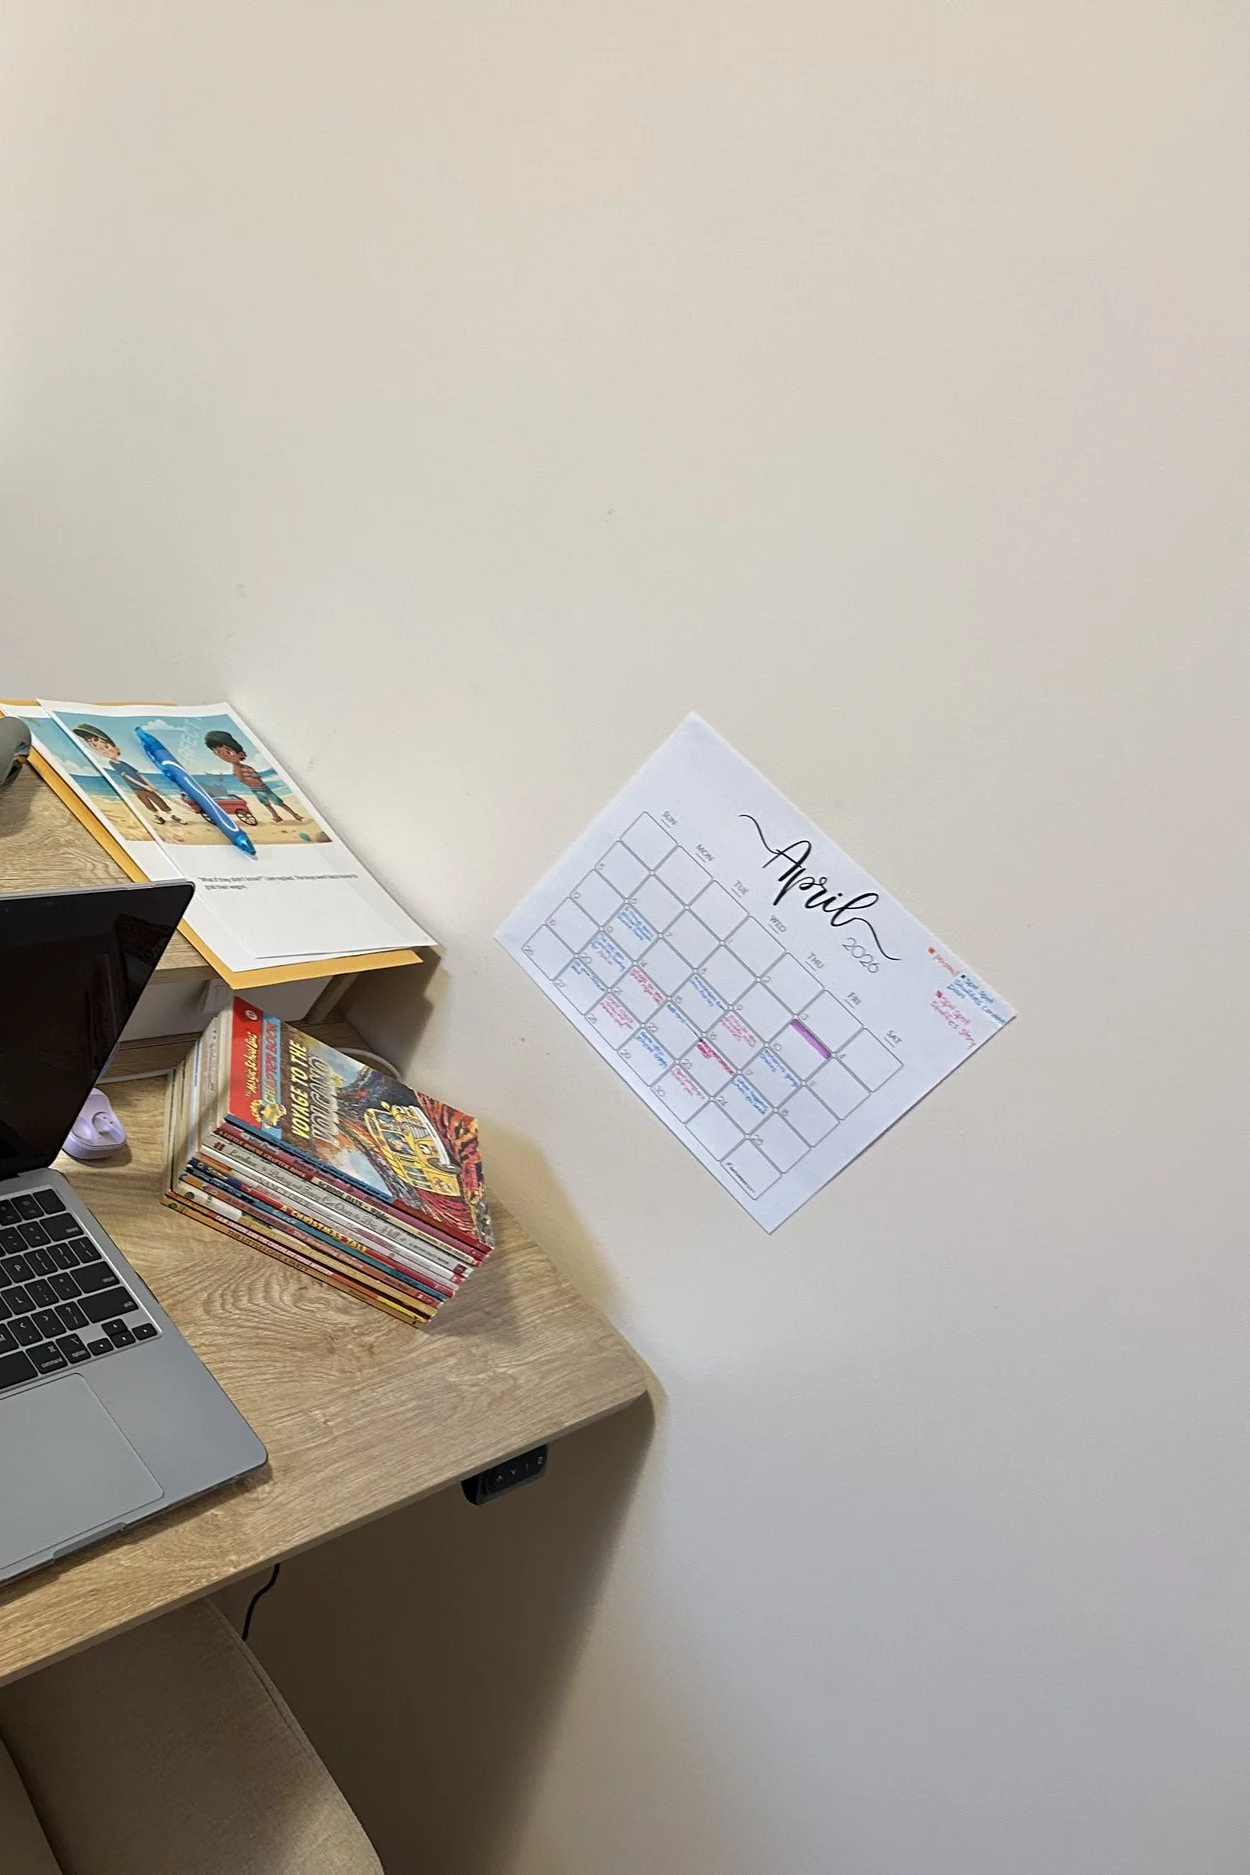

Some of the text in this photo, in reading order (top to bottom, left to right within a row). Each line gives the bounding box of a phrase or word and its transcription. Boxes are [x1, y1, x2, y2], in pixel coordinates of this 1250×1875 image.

[739, 813, 902, 962] April
[661, 810, 903, 1046] SUN MON TUE WED THU FRI SAT
[842, 936, 880, 974] 2026
[245, 1029, 257, 1092] Magic School Bus
[263, 1020, 277, 1104] CHAPTER BOOK
[288, 1038, 310, 1138] VOYAGE TO THE
[308, 1054, 337, 1145] VOLCANO
[258, 1178, 285, 1194] NANCY
[317, 1181, 362, 1206] SCHOOL DAYS
[226, 1230, 241, 1238] THE
[290, 1211, 342, 1238] CHRISTMAS
[346, 1238, 366, 1251] TALE
